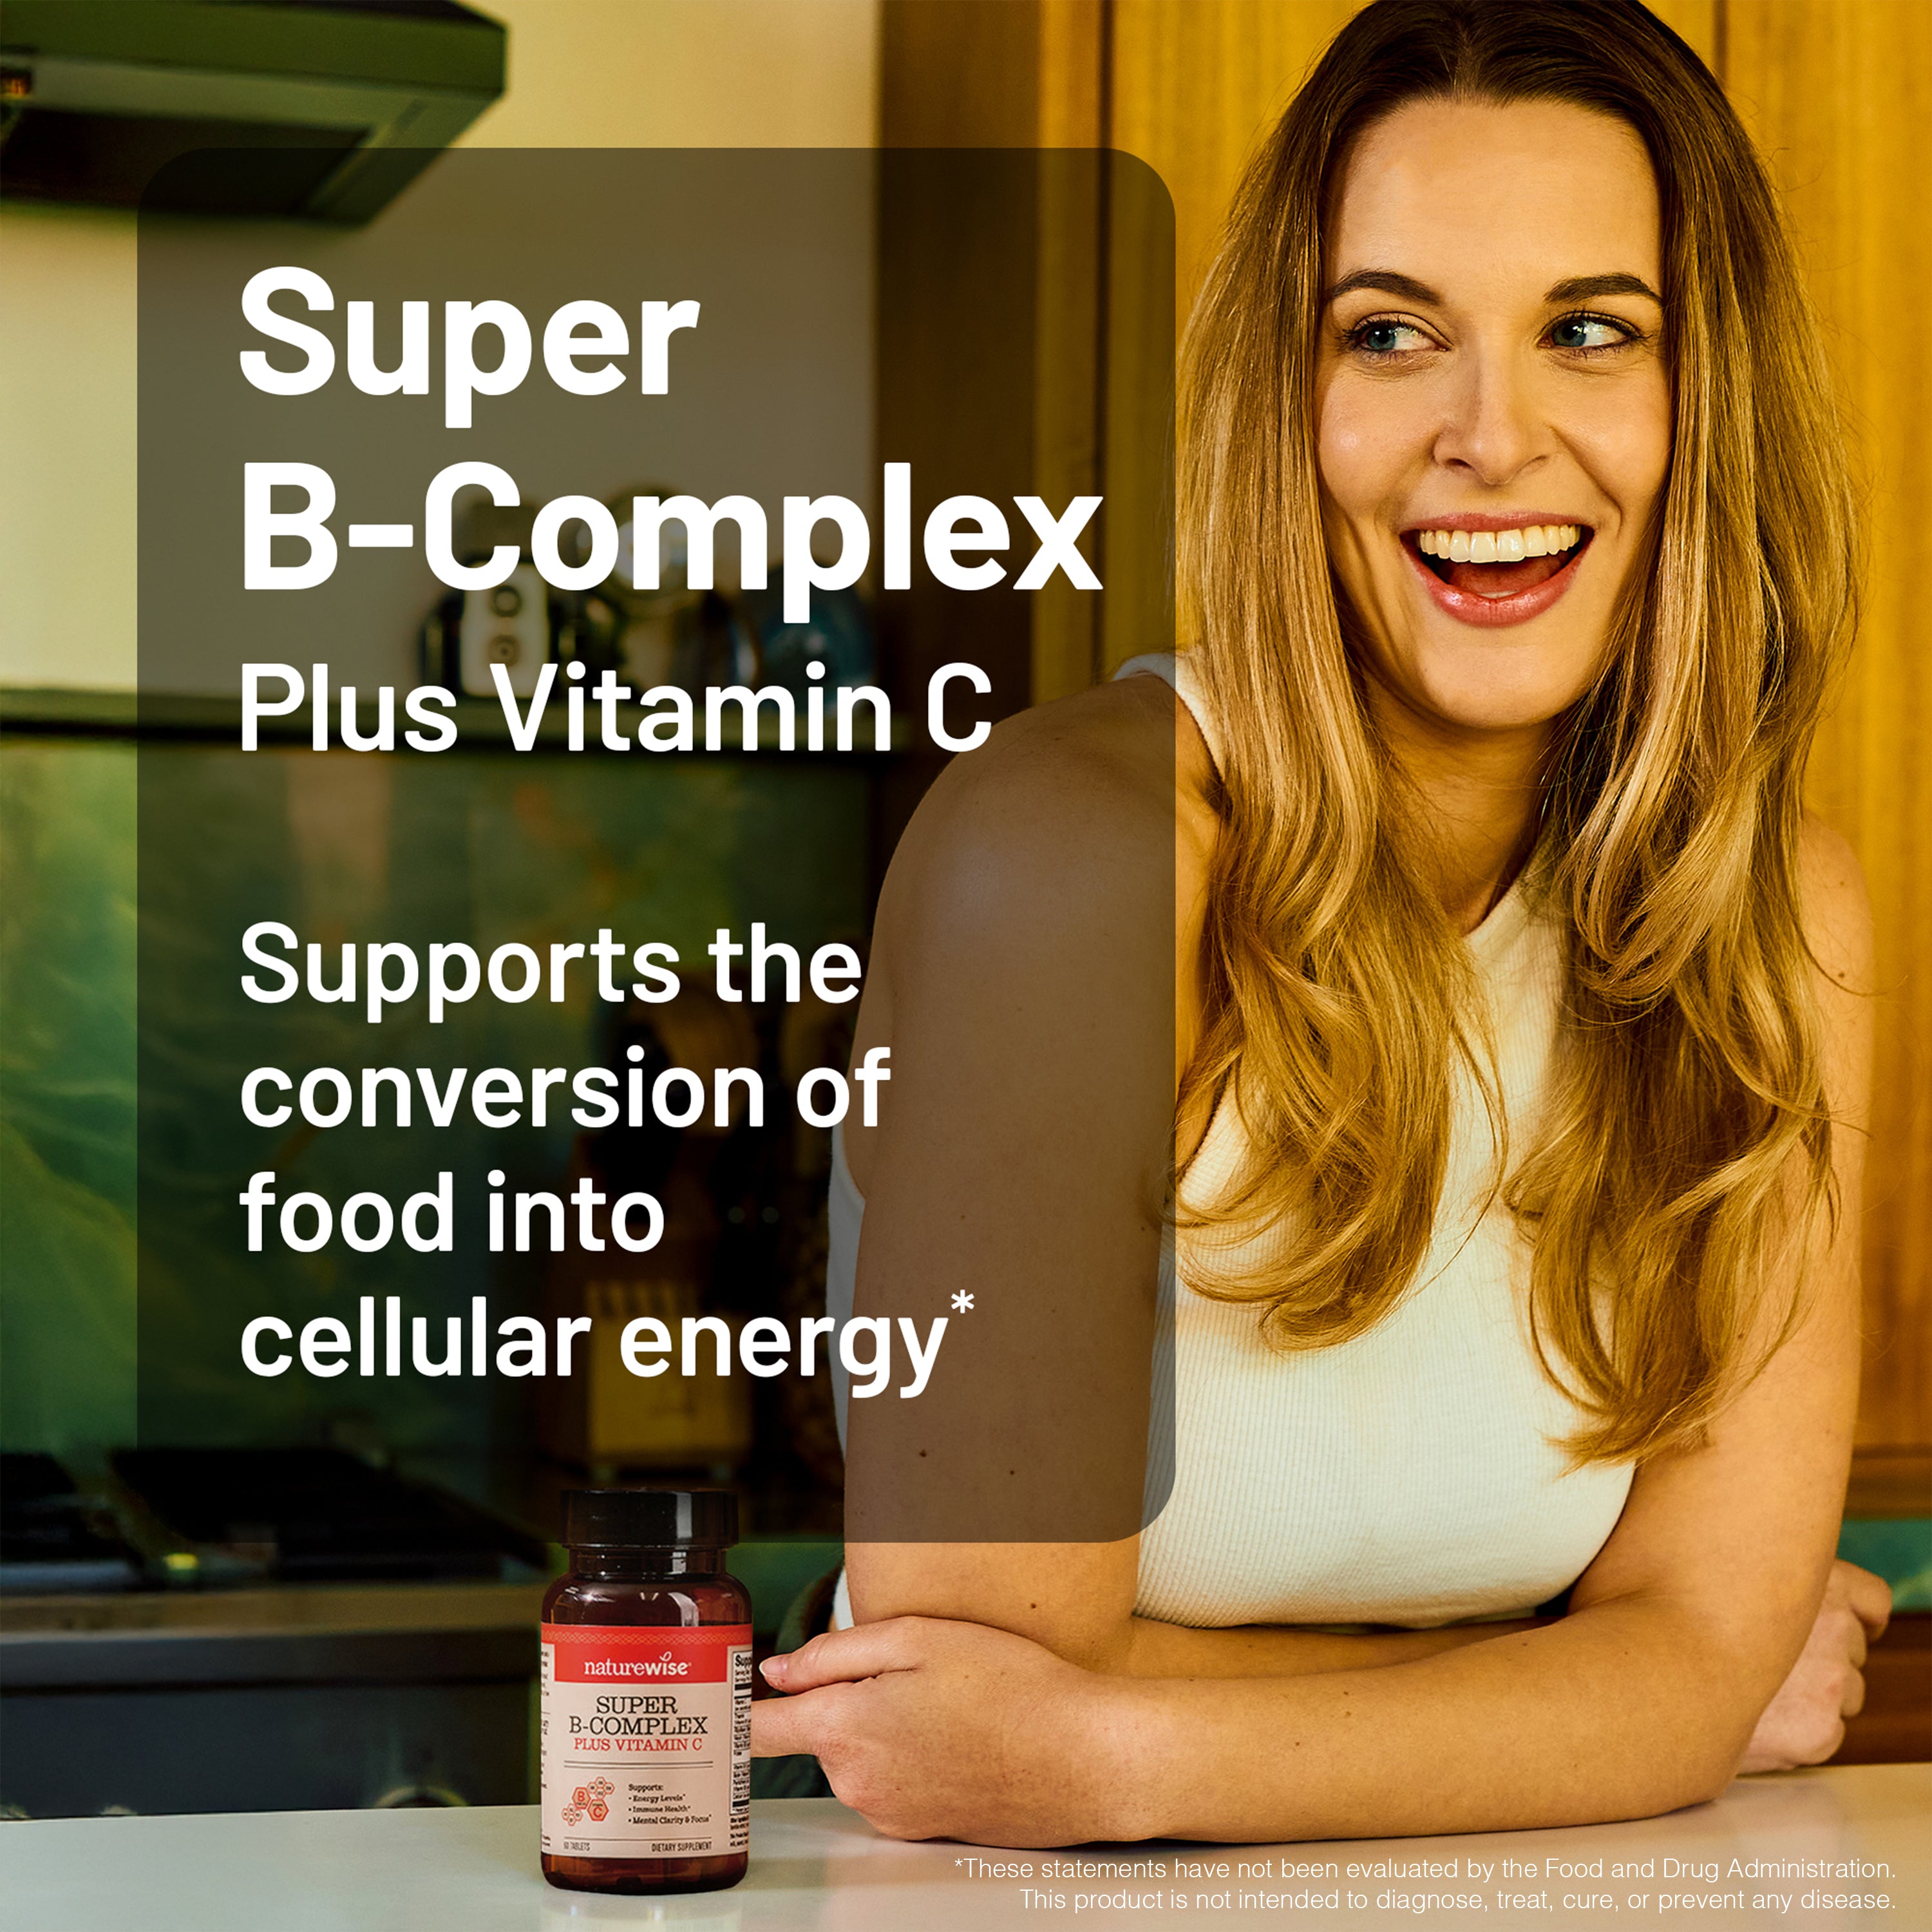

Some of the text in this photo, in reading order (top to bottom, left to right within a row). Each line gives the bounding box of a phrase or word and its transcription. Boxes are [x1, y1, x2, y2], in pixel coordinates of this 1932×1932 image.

[596, 1696, 677, 1714] SUPER
[569, 1716, 708, 1735] B-COMPLEX
[574, 1738, 702, 1751] PLUS VITAMIN C
[629, 1784, 663, 1793] Supports:
[578, 1791, 585, 1802] B
[593, 1806, 602, 1817] C
[570, 1842, 591, 1851] TABLETS
[652, 1841, 712, 1852] DIETARY SUPPLEMENT
